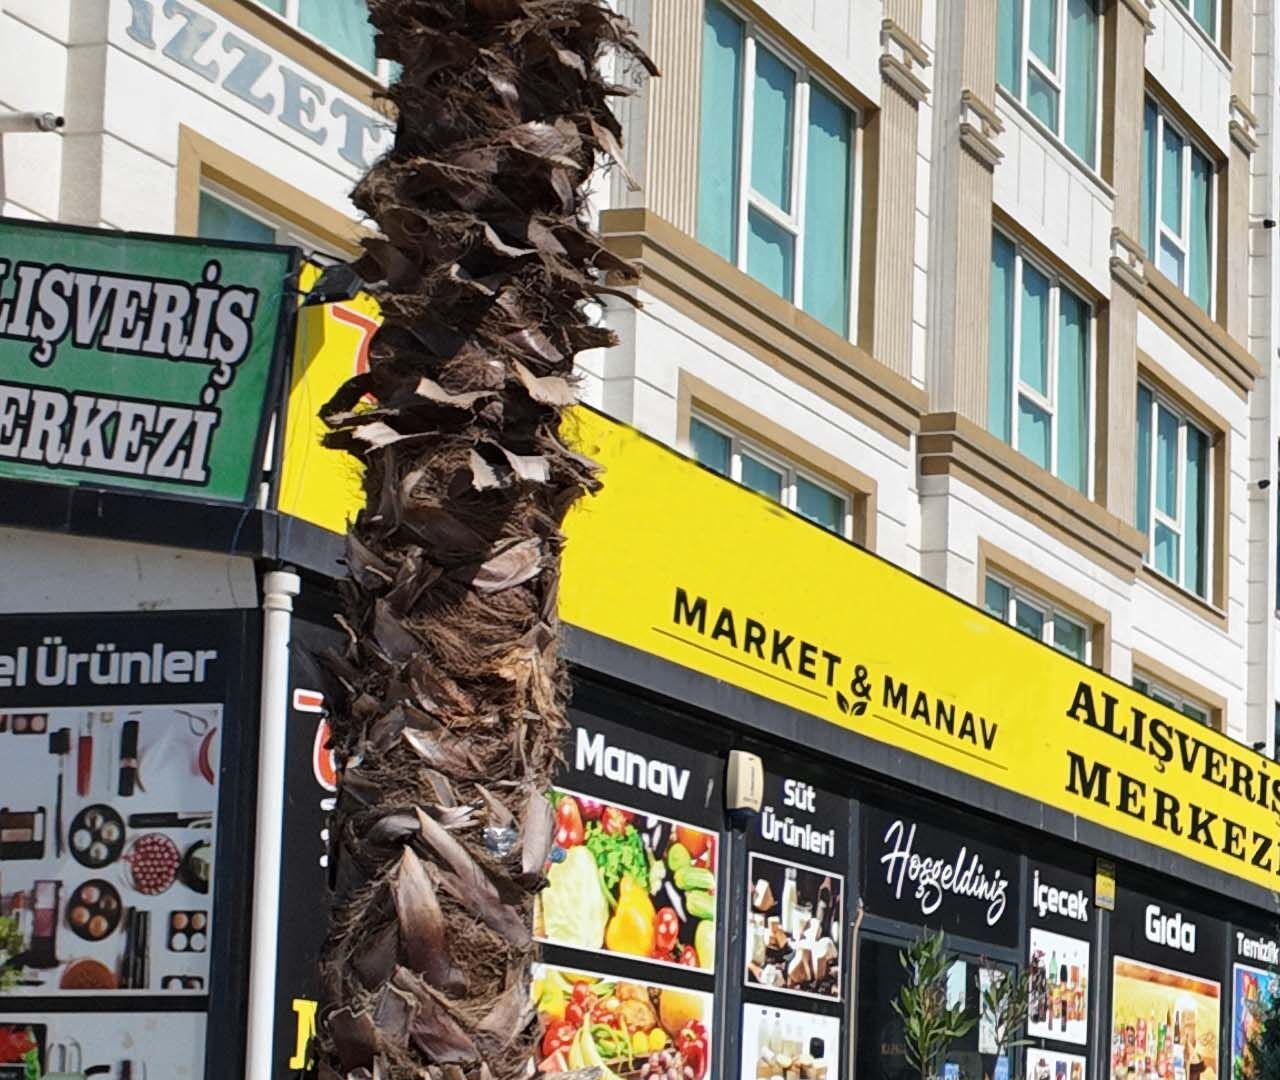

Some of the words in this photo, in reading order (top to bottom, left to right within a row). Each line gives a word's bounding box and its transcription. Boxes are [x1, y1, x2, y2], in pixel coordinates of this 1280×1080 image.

[35, 636, 218, 686] Ürünler
[672, 586, 841, 687] MARKET
[850, 664, 872, 700] &
[883, 674, 999, 752] MANAV
[575, 727, 691, 801] Manav
[783, 778, 817, 814] Süt
[761, 806, 835, 858] Ürünleri
[880, 819, 1009, 926] Hoşgeldiniz
[1032, 869, 1089, 922] İçecek
[1145, 903, 1196, 953] Gıda
